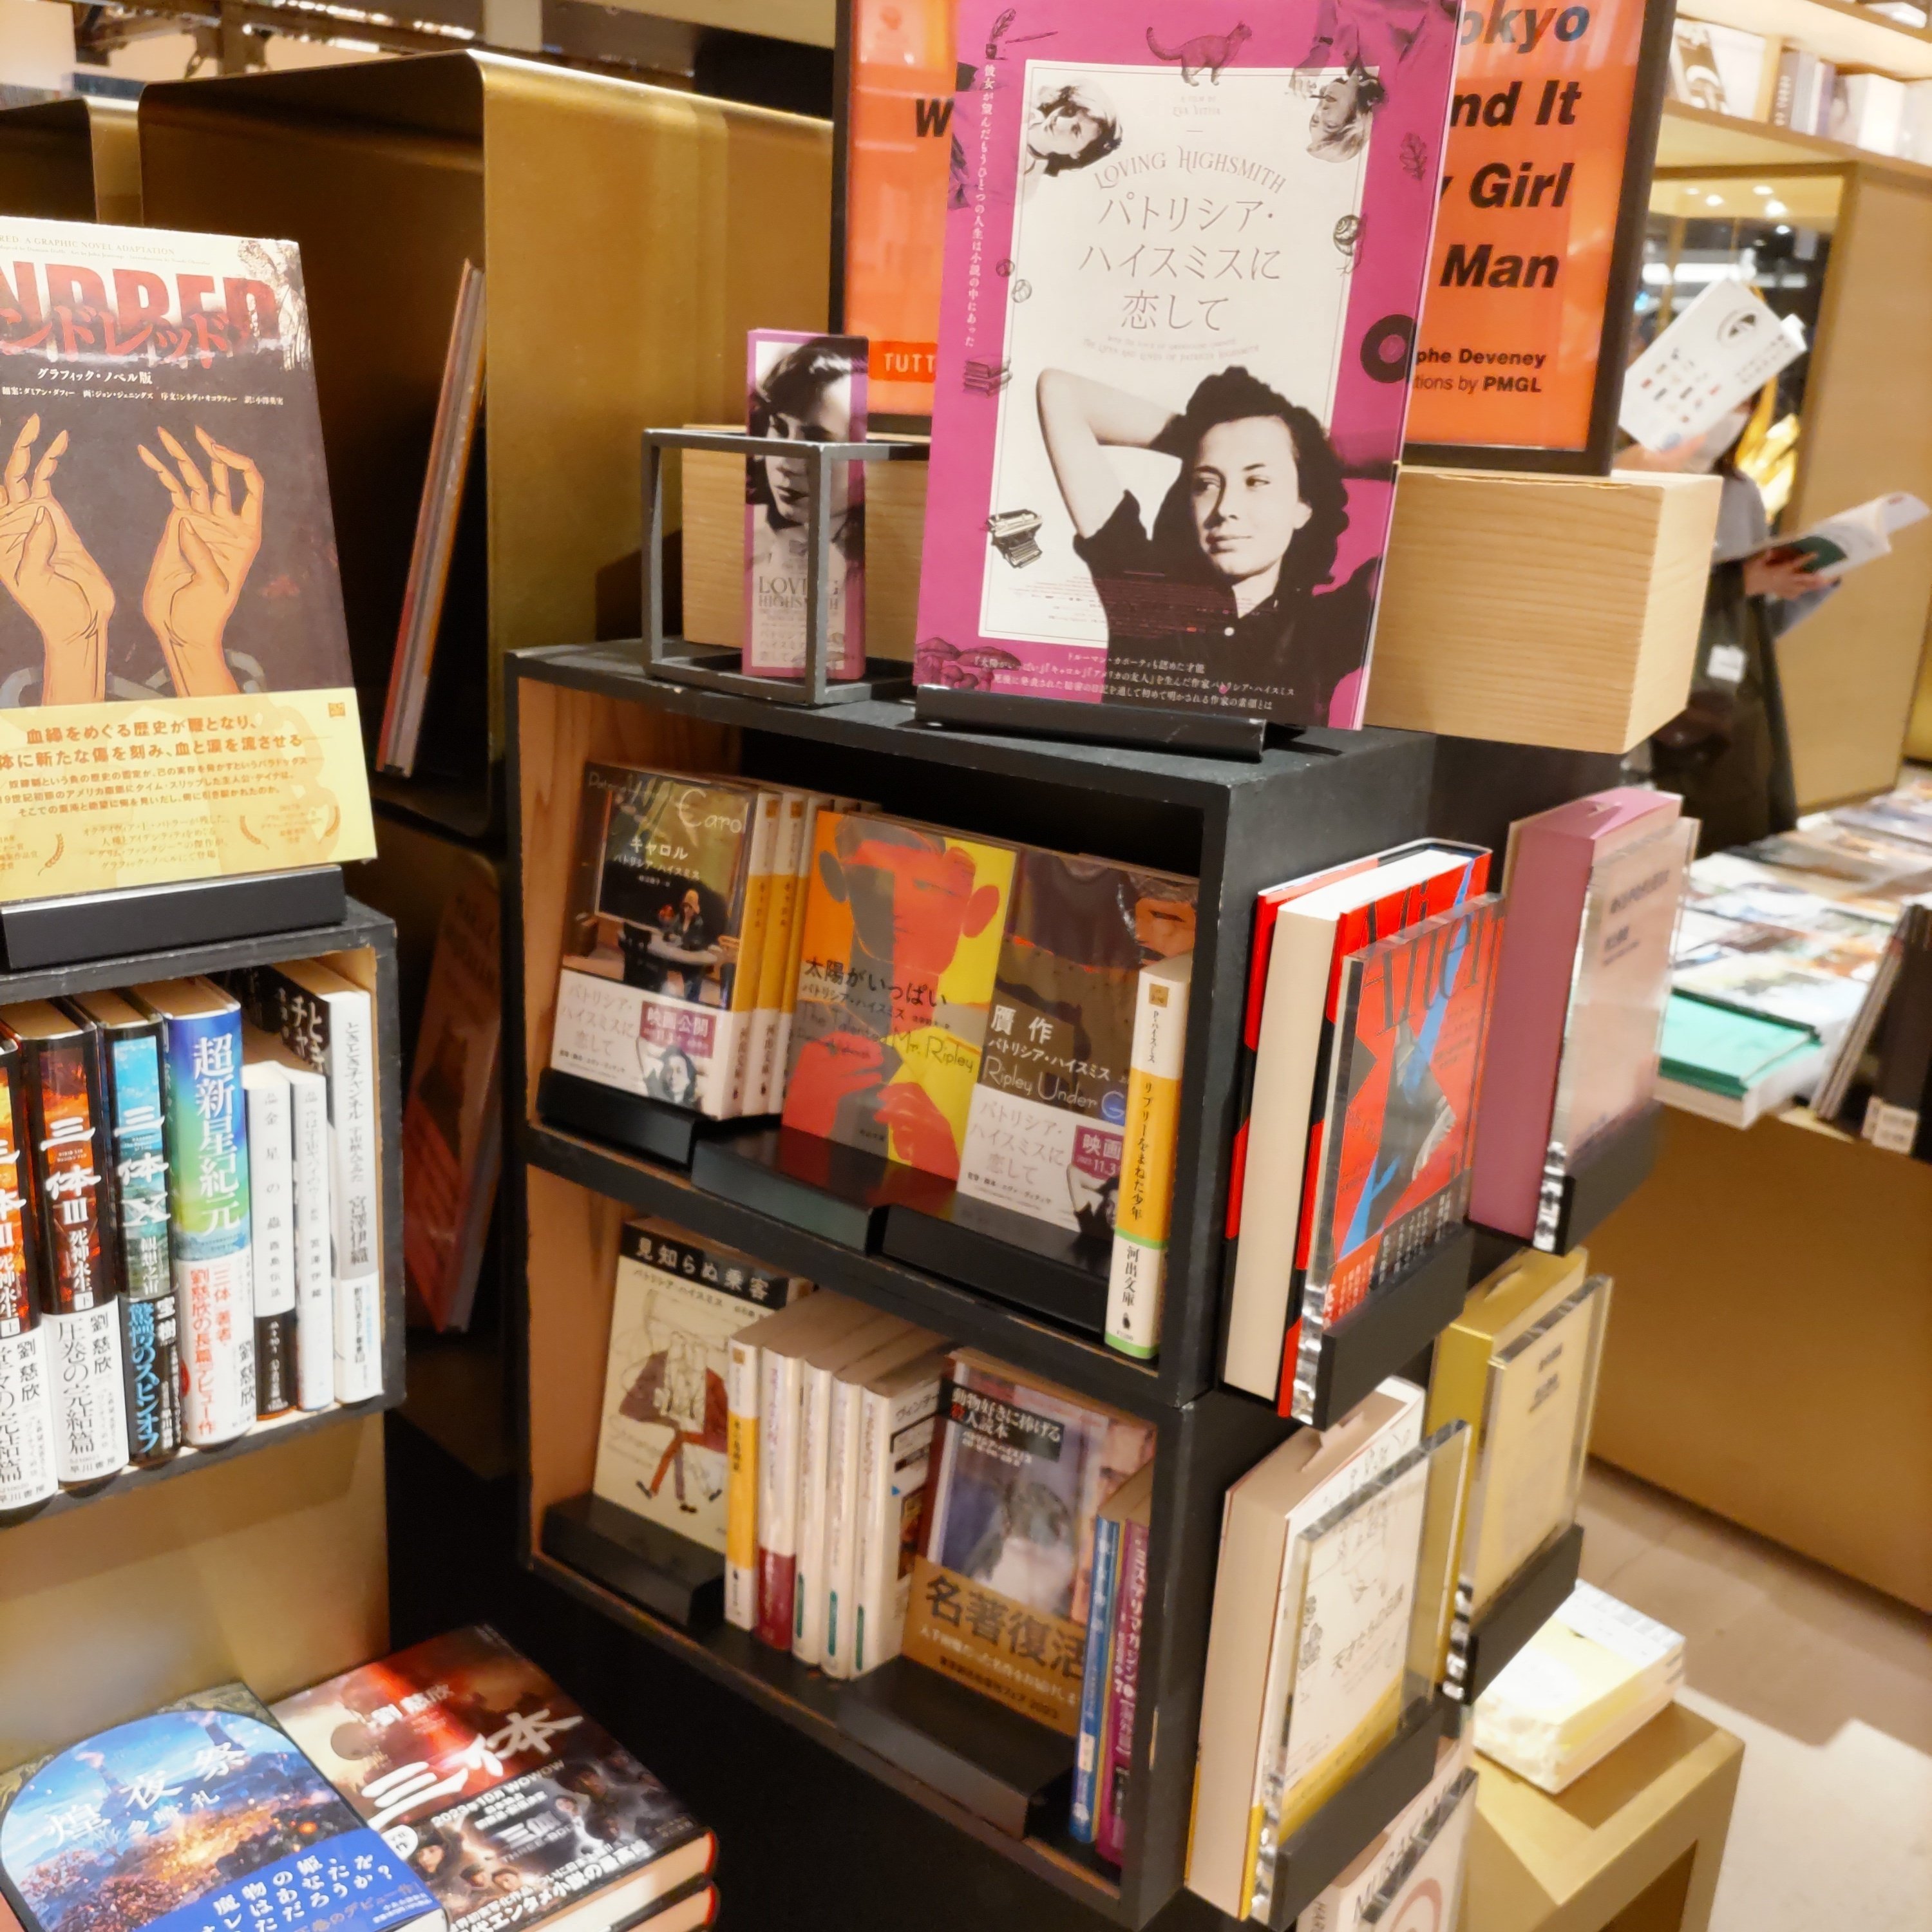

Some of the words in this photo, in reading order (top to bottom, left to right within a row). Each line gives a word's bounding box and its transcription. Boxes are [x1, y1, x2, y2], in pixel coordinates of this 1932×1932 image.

[1535, 80, 1582, 126] It
[1094, 152, 1166, 189] LOVING
[1177, 145, 1287, 194] HIGHSMITH
[1469, 162, 1575, 208] Girl
[1079, 243, 1280, 280] ハイスミスに
[1439, 243, 1559, 288] Man
[1121, 290, 1229, 331] 恋して
[37, 367, 153, 385] グラフィック・ノベル版
[1459, 348, 1546, 369] Deveney
[1458, 376, 1479, 394] by
[1482, 377, 1542, 392] PMGL
[630, 835, 688, 861] キャロル
[804, 956, 948, 1007] 太陽がいっぱい
[990, 1004, 1054, 1045] 贋作
[925, 1035, 973, 1074] Ripley
[988, 1038, 1111, 1082] パトリシア・ハイスミス
[983, 1055, 1033, 1095] Ripley
[1037, 1070, 1097, 1110] Under
[193, 1032, 241, 1236] 超新星紀元
[1130, 1081, 1153, 1222] リプリーをまねた少年
[40, 1115, 101, 1226] 三体III
[114, 1105, 171, 1227] 三体X
[68, 1226, 92, 1292] 死神永生
[635, 1236, 770, 1302] 見知らぬ乗客
[1122, 1244, 1141, 1307] 河出文庫
[90, 1312, 113, 1374] 劉慈欣
[17, 1339, 41, 1403] 劉慈欣
[59, 1317, 95, 1455] 圧巻の完結篇
[925, 1574, 1086, 1681] 名著復活
[44, 1741, 251, 1848] 煌夜祭
[361, 1708, 584, 1831] 三体
[502, 1759, 565, 1794] WOWOW
